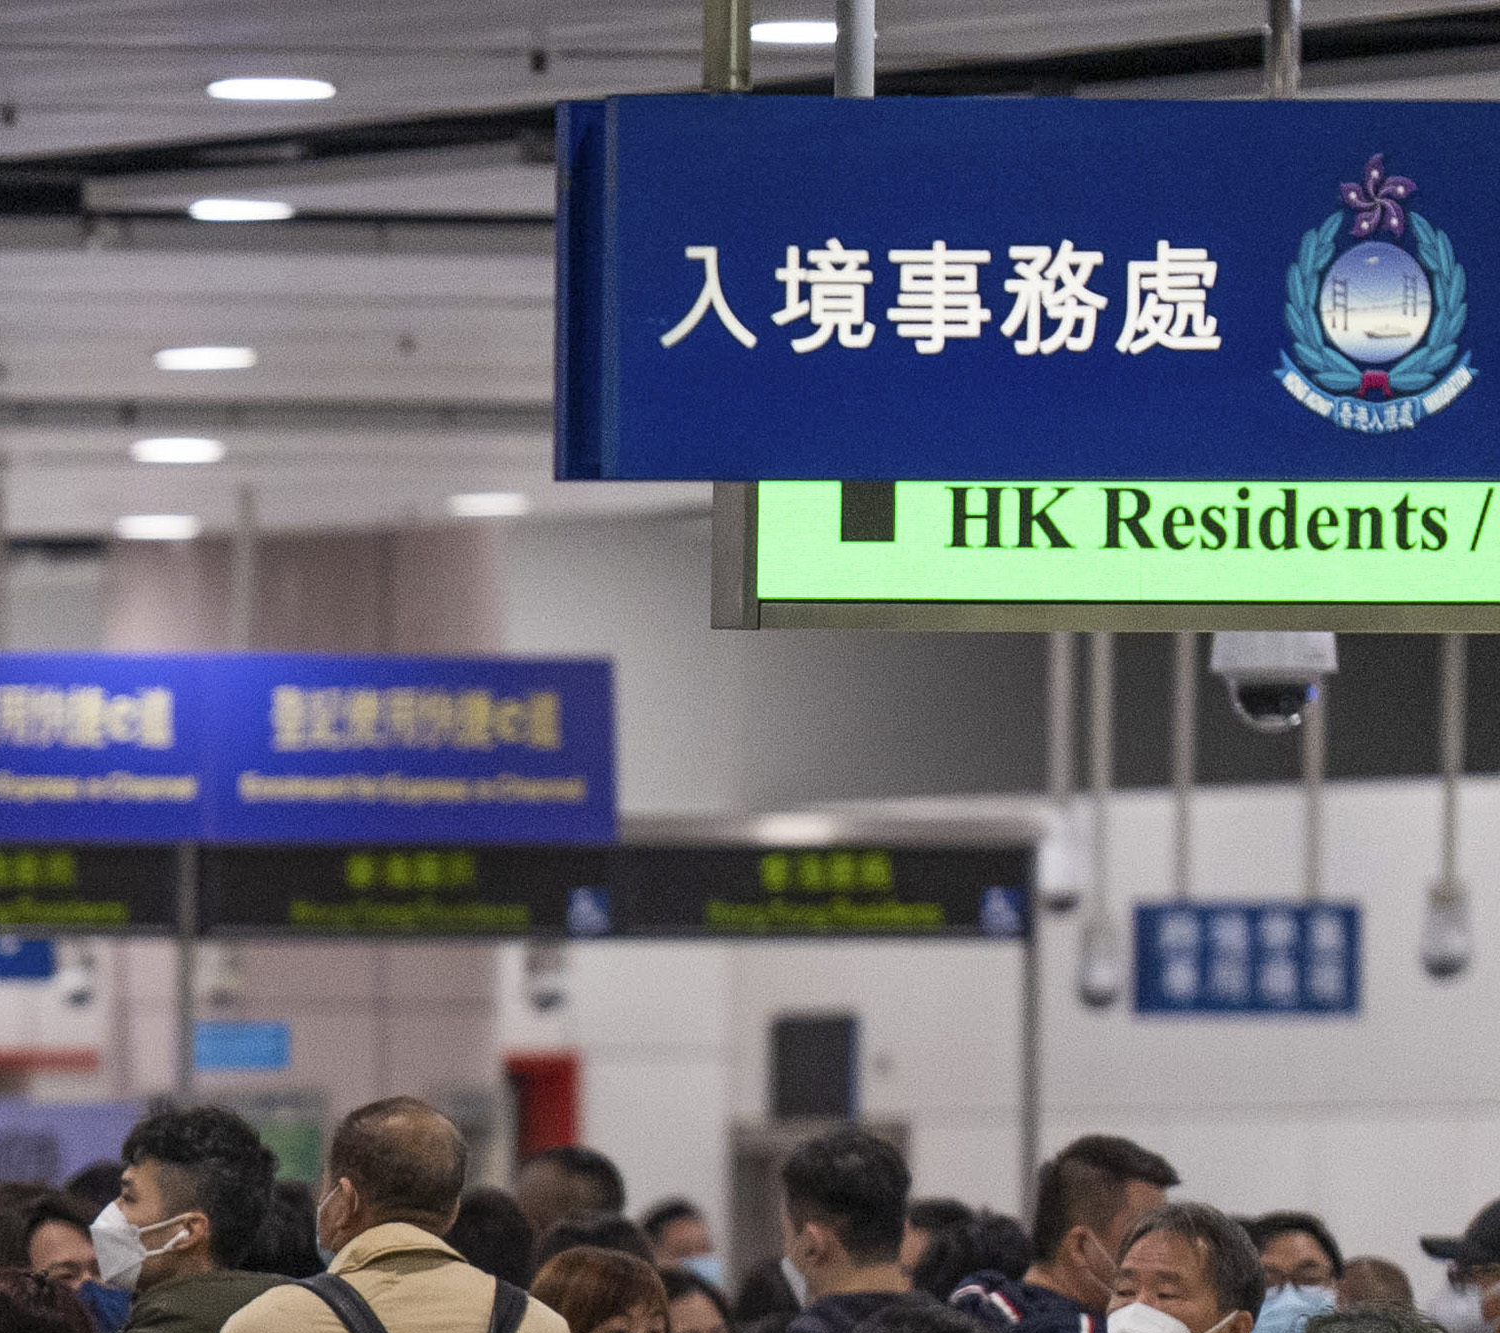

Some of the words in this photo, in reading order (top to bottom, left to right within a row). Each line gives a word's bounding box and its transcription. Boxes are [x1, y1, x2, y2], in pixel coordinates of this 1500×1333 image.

[659, 237, 1223, 357] 入境事務處
[944, 485, 1077, 549] HK
[1098, 486, 1449, 551] Residents
